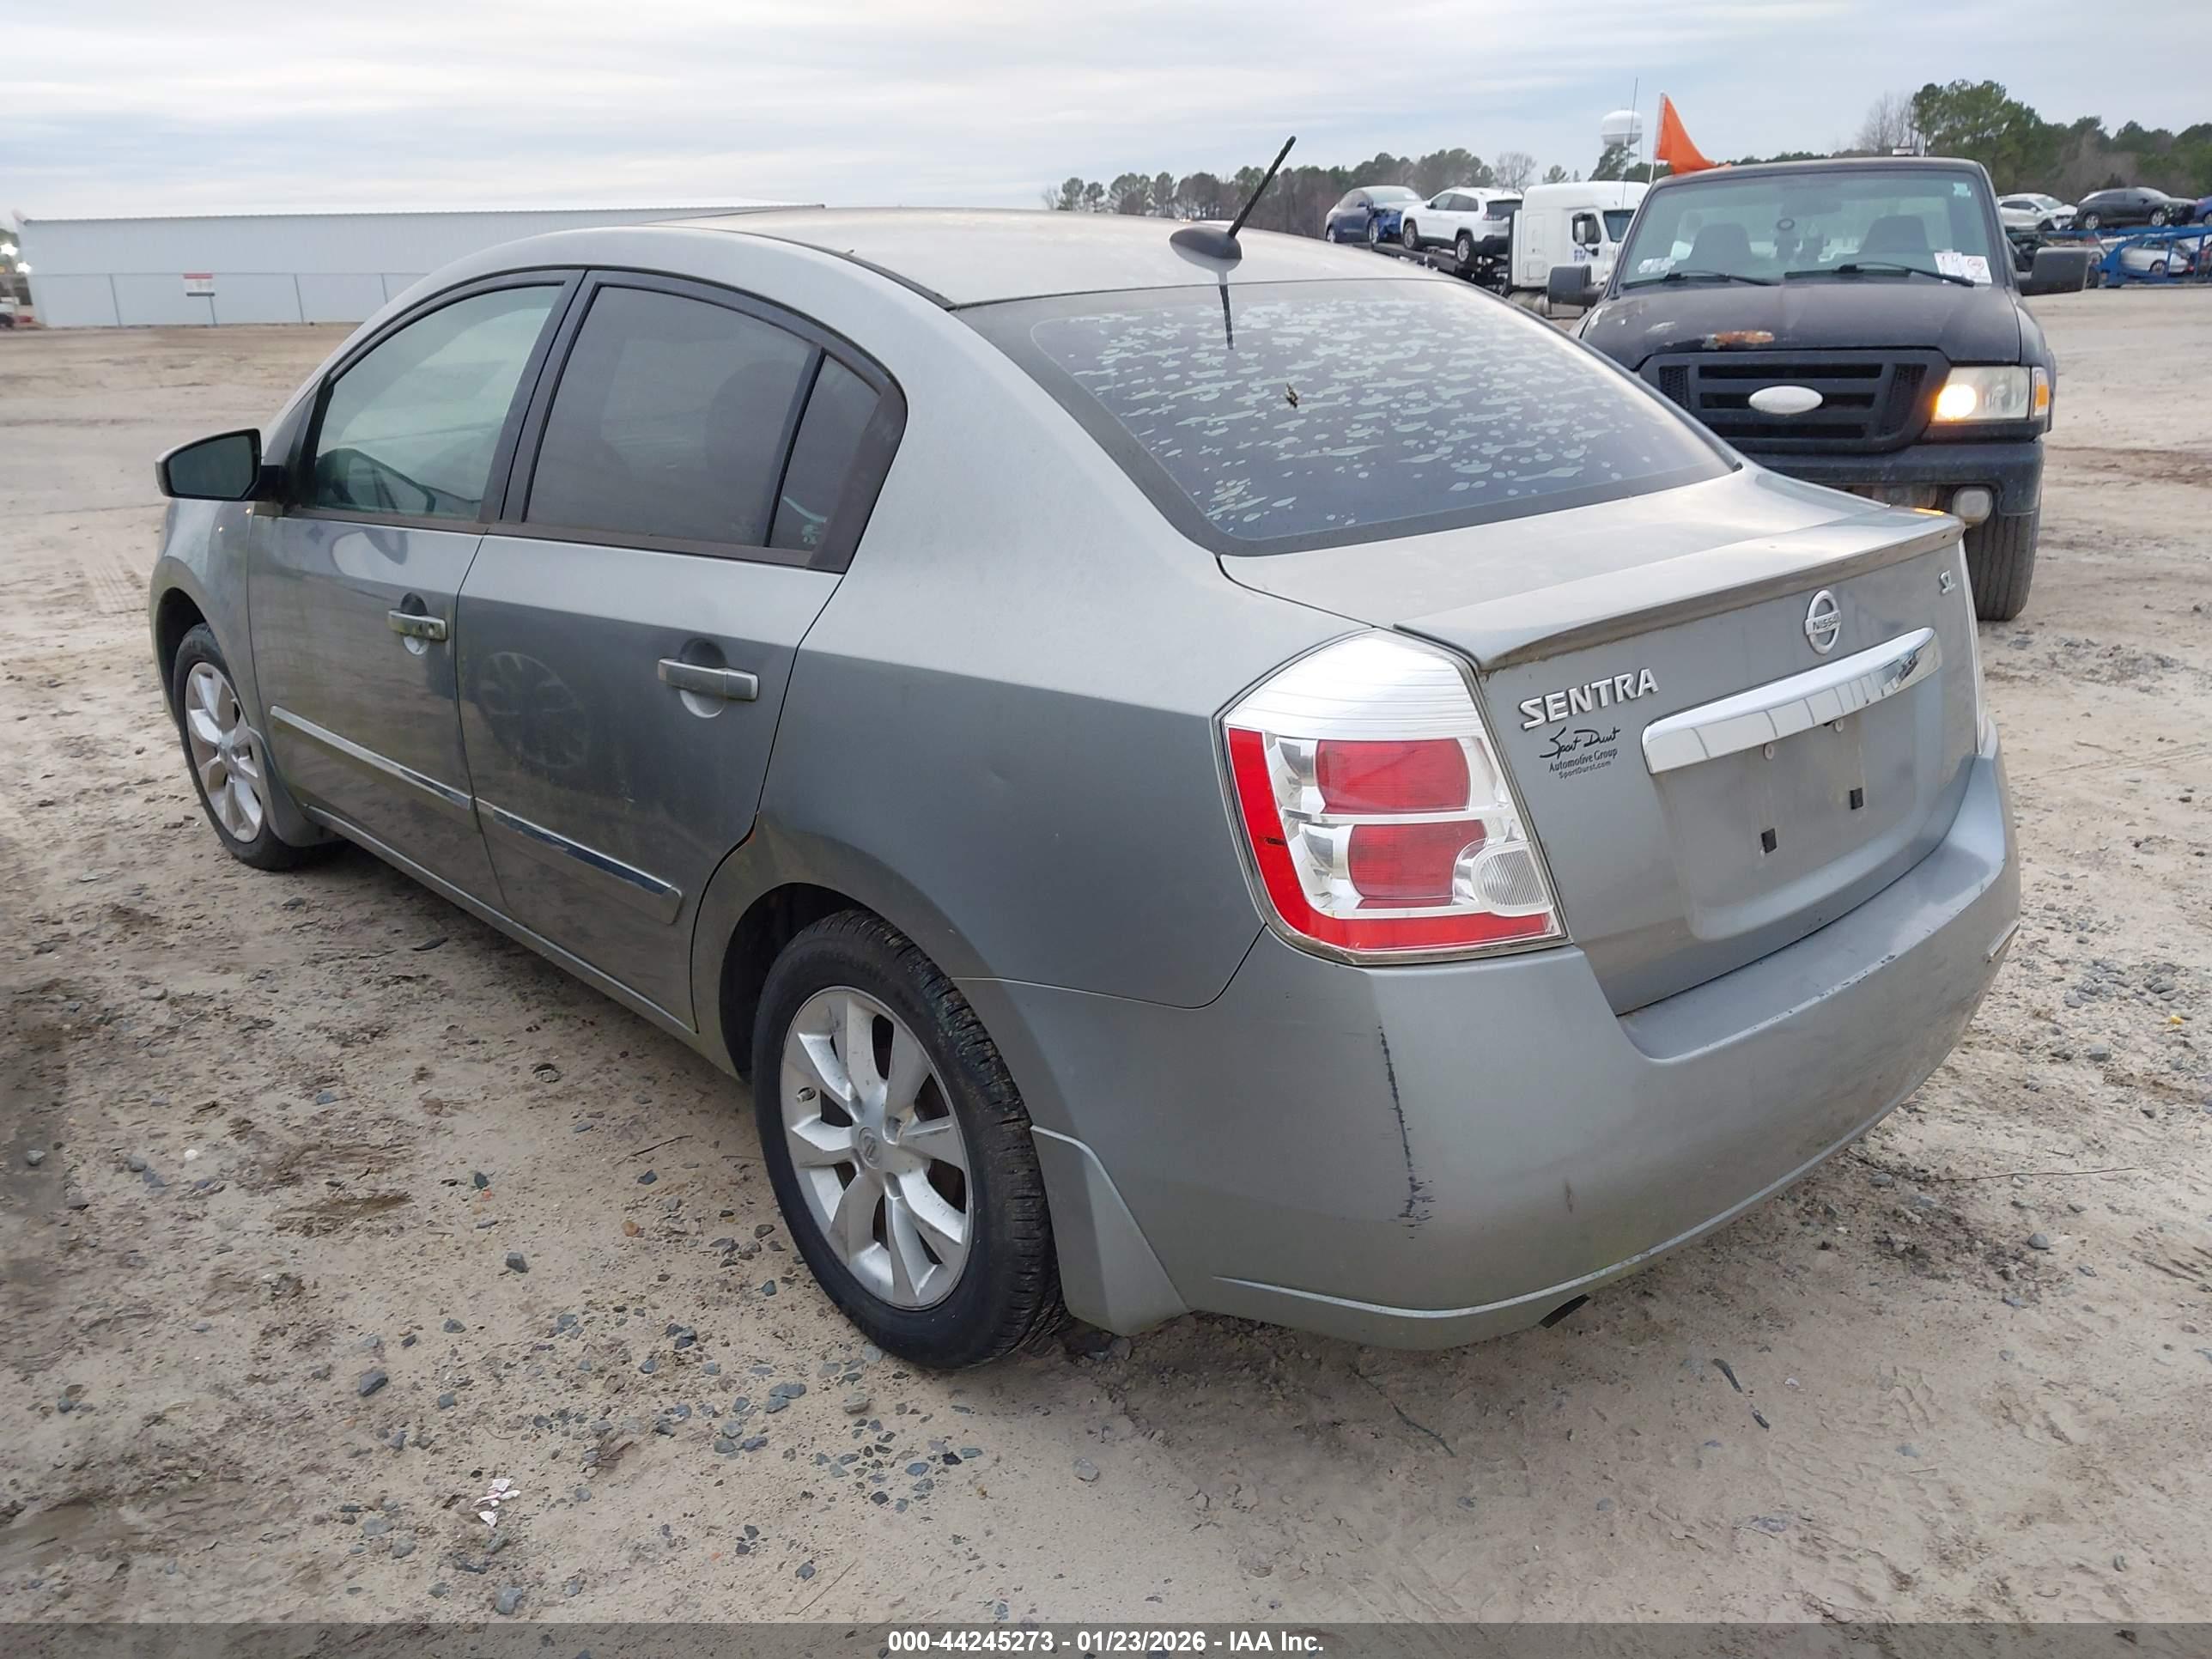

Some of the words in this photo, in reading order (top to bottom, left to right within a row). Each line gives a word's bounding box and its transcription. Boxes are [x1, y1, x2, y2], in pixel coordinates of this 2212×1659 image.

[1518, 668, 1659, 730] SENTRA
[1549, 754, 1594, 773] Automotive
[1593, 748, 1618, 759] Group
